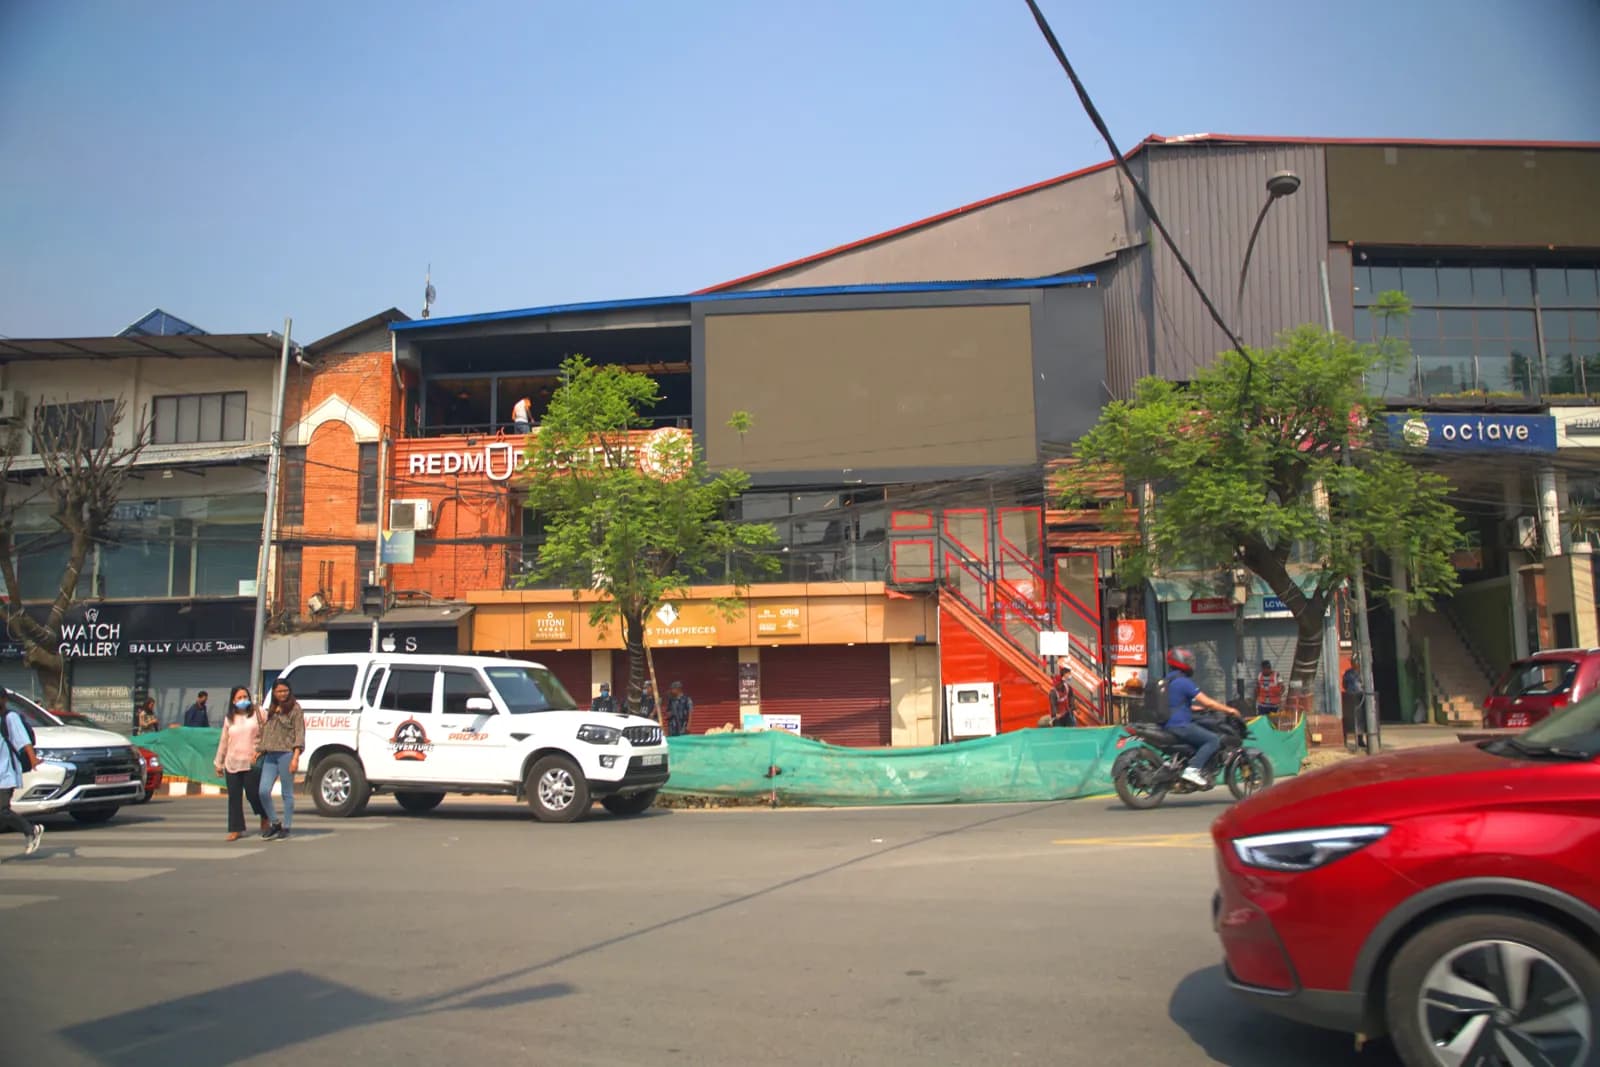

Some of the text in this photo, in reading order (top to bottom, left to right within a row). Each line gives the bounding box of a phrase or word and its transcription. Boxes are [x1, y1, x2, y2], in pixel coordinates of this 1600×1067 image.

[1443, 420, 1529, 440] octave
[60, 623, 121, 640] WATCH
[656, 626, 716, 635] TIMEPIECES
[58, 642, 121, 657] GALLERY
[129, 643, 172, 653] BALLY
